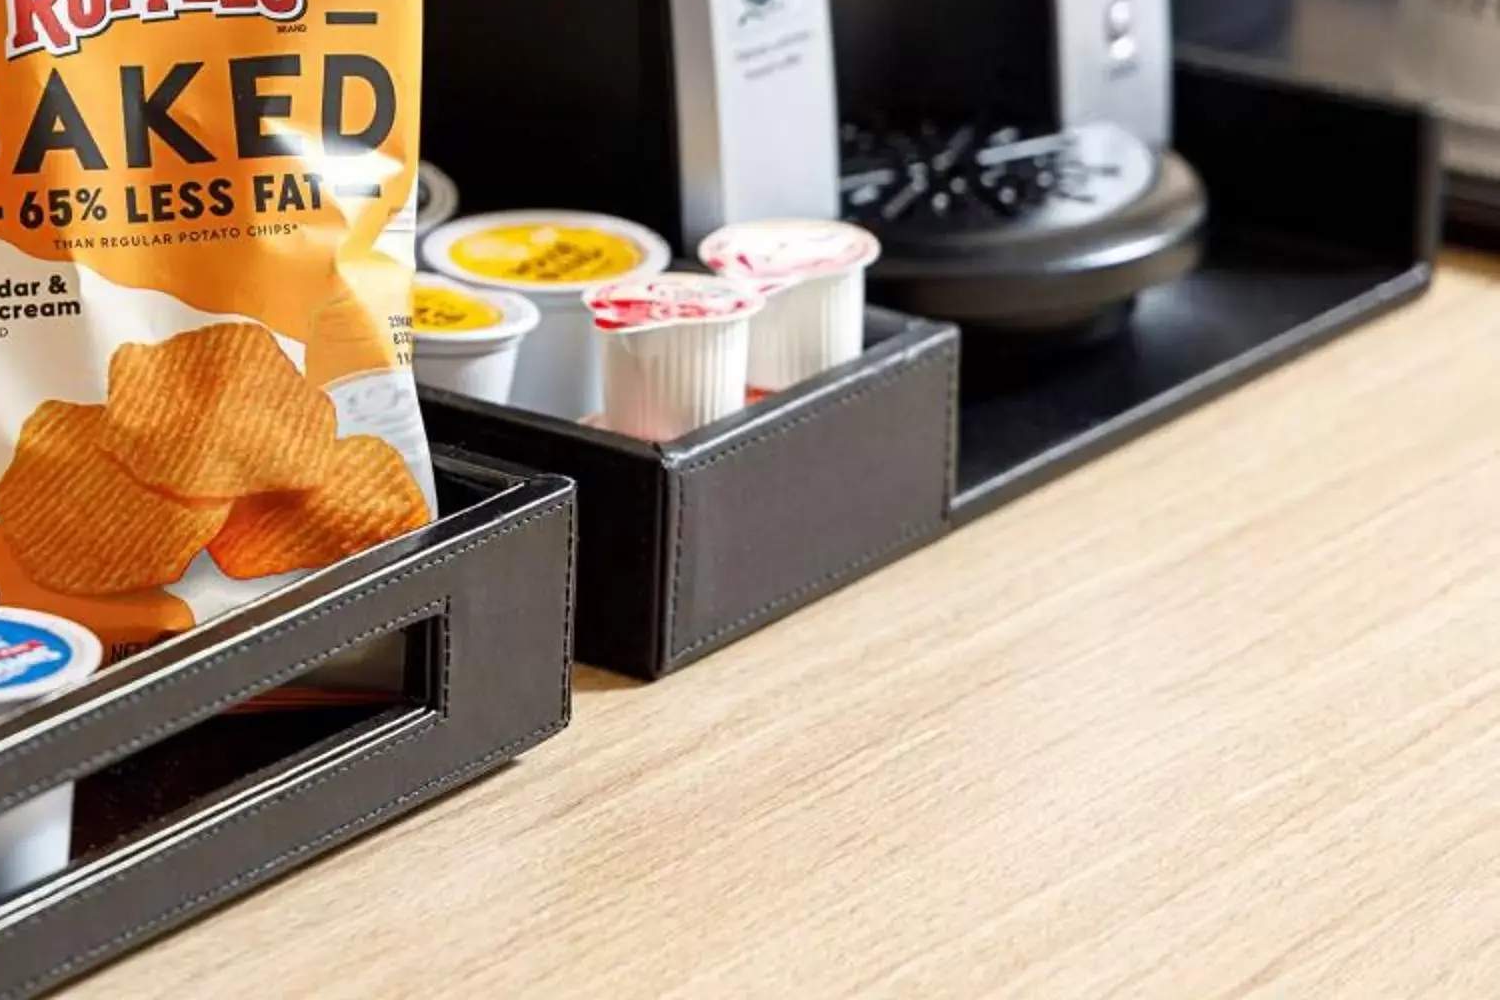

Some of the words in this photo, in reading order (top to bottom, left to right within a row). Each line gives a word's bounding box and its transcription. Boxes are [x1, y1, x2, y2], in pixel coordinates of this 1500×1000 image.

[18, 186, 108, 230] 65%
[125, 177, 235, 224] LESS
[252, 173, 325, 213] FAT
[53, 238, 96, 250] THAN
[99, 232, 173, 248] REGULAR
[178, 227, 242, 243] POTATO
[48, 275, 68, 296] &
